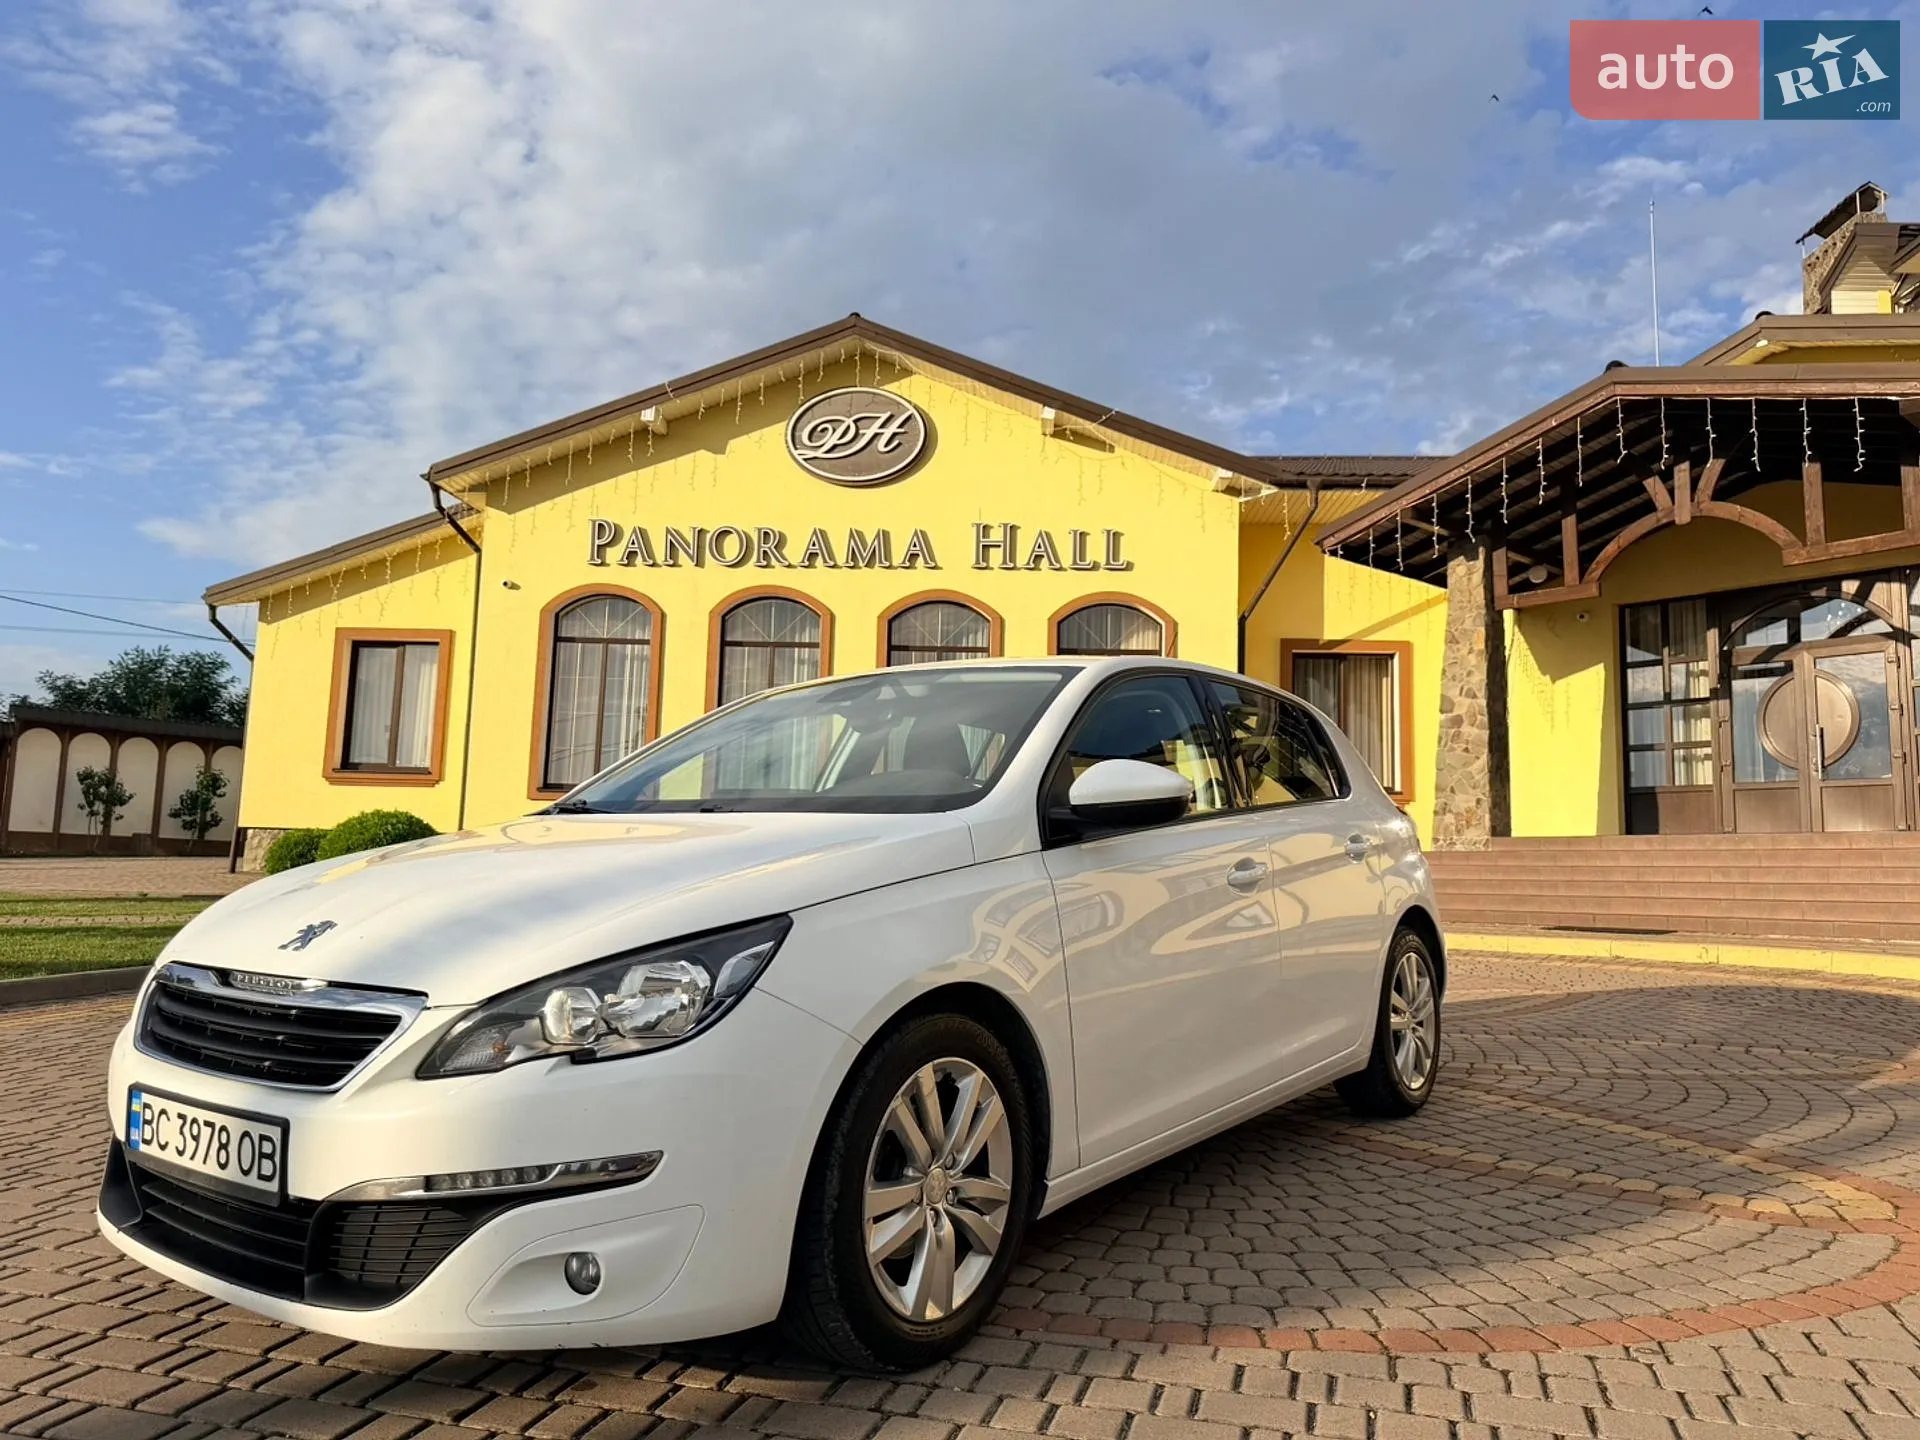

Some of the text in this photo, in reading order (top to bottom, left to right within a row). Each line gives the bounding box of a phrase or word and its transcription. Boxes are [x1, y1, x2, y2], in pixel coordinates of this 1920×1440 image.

[586, 518, 1132, 571] PANORAMA HALL
[141, 1102, 277, 1182] BC 3978 OB
